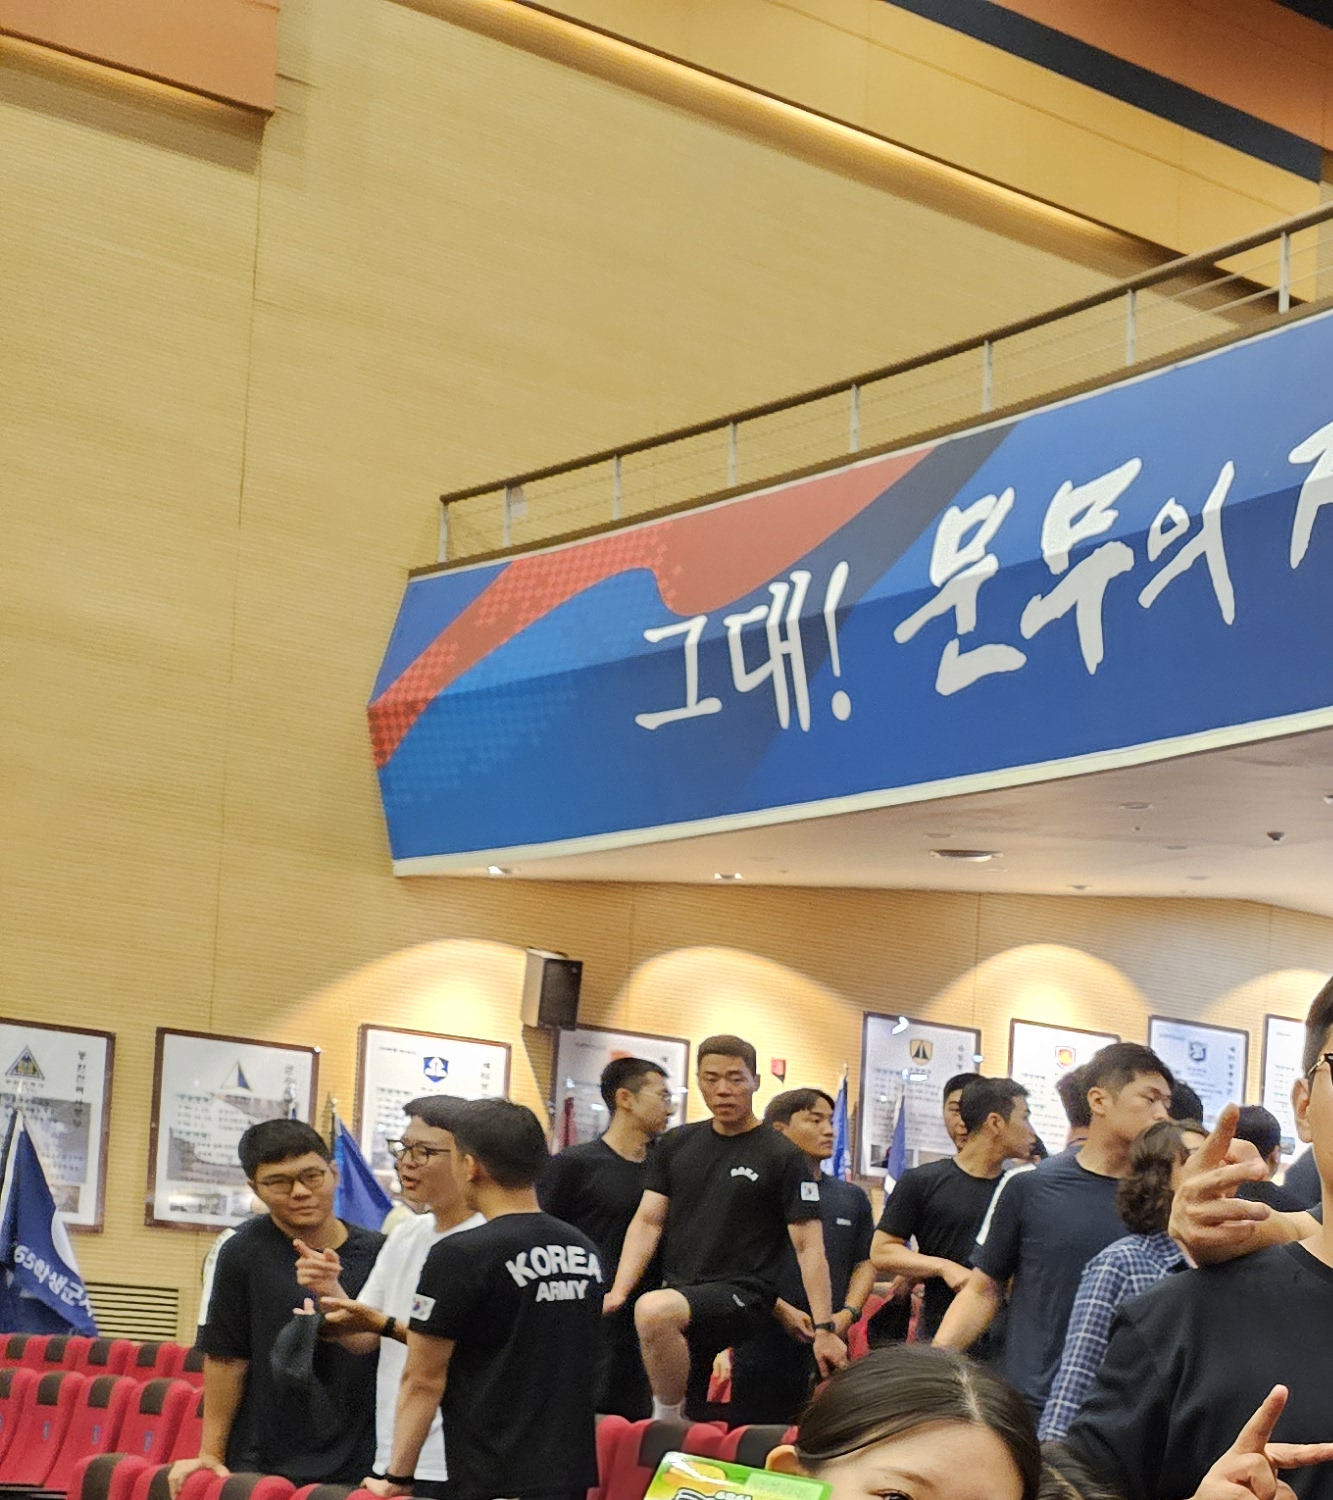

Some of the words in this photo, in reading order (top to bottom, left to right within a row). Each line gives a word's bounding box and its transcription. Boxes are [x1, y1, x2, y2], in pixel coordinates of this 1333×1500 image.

[635, 560, 852, 732] 그대!
[895, 456, 1238, 697] 문무의
[505, 1244, 604, 1288] KOREA
[535, 1279, 590, 1303] ARMY
